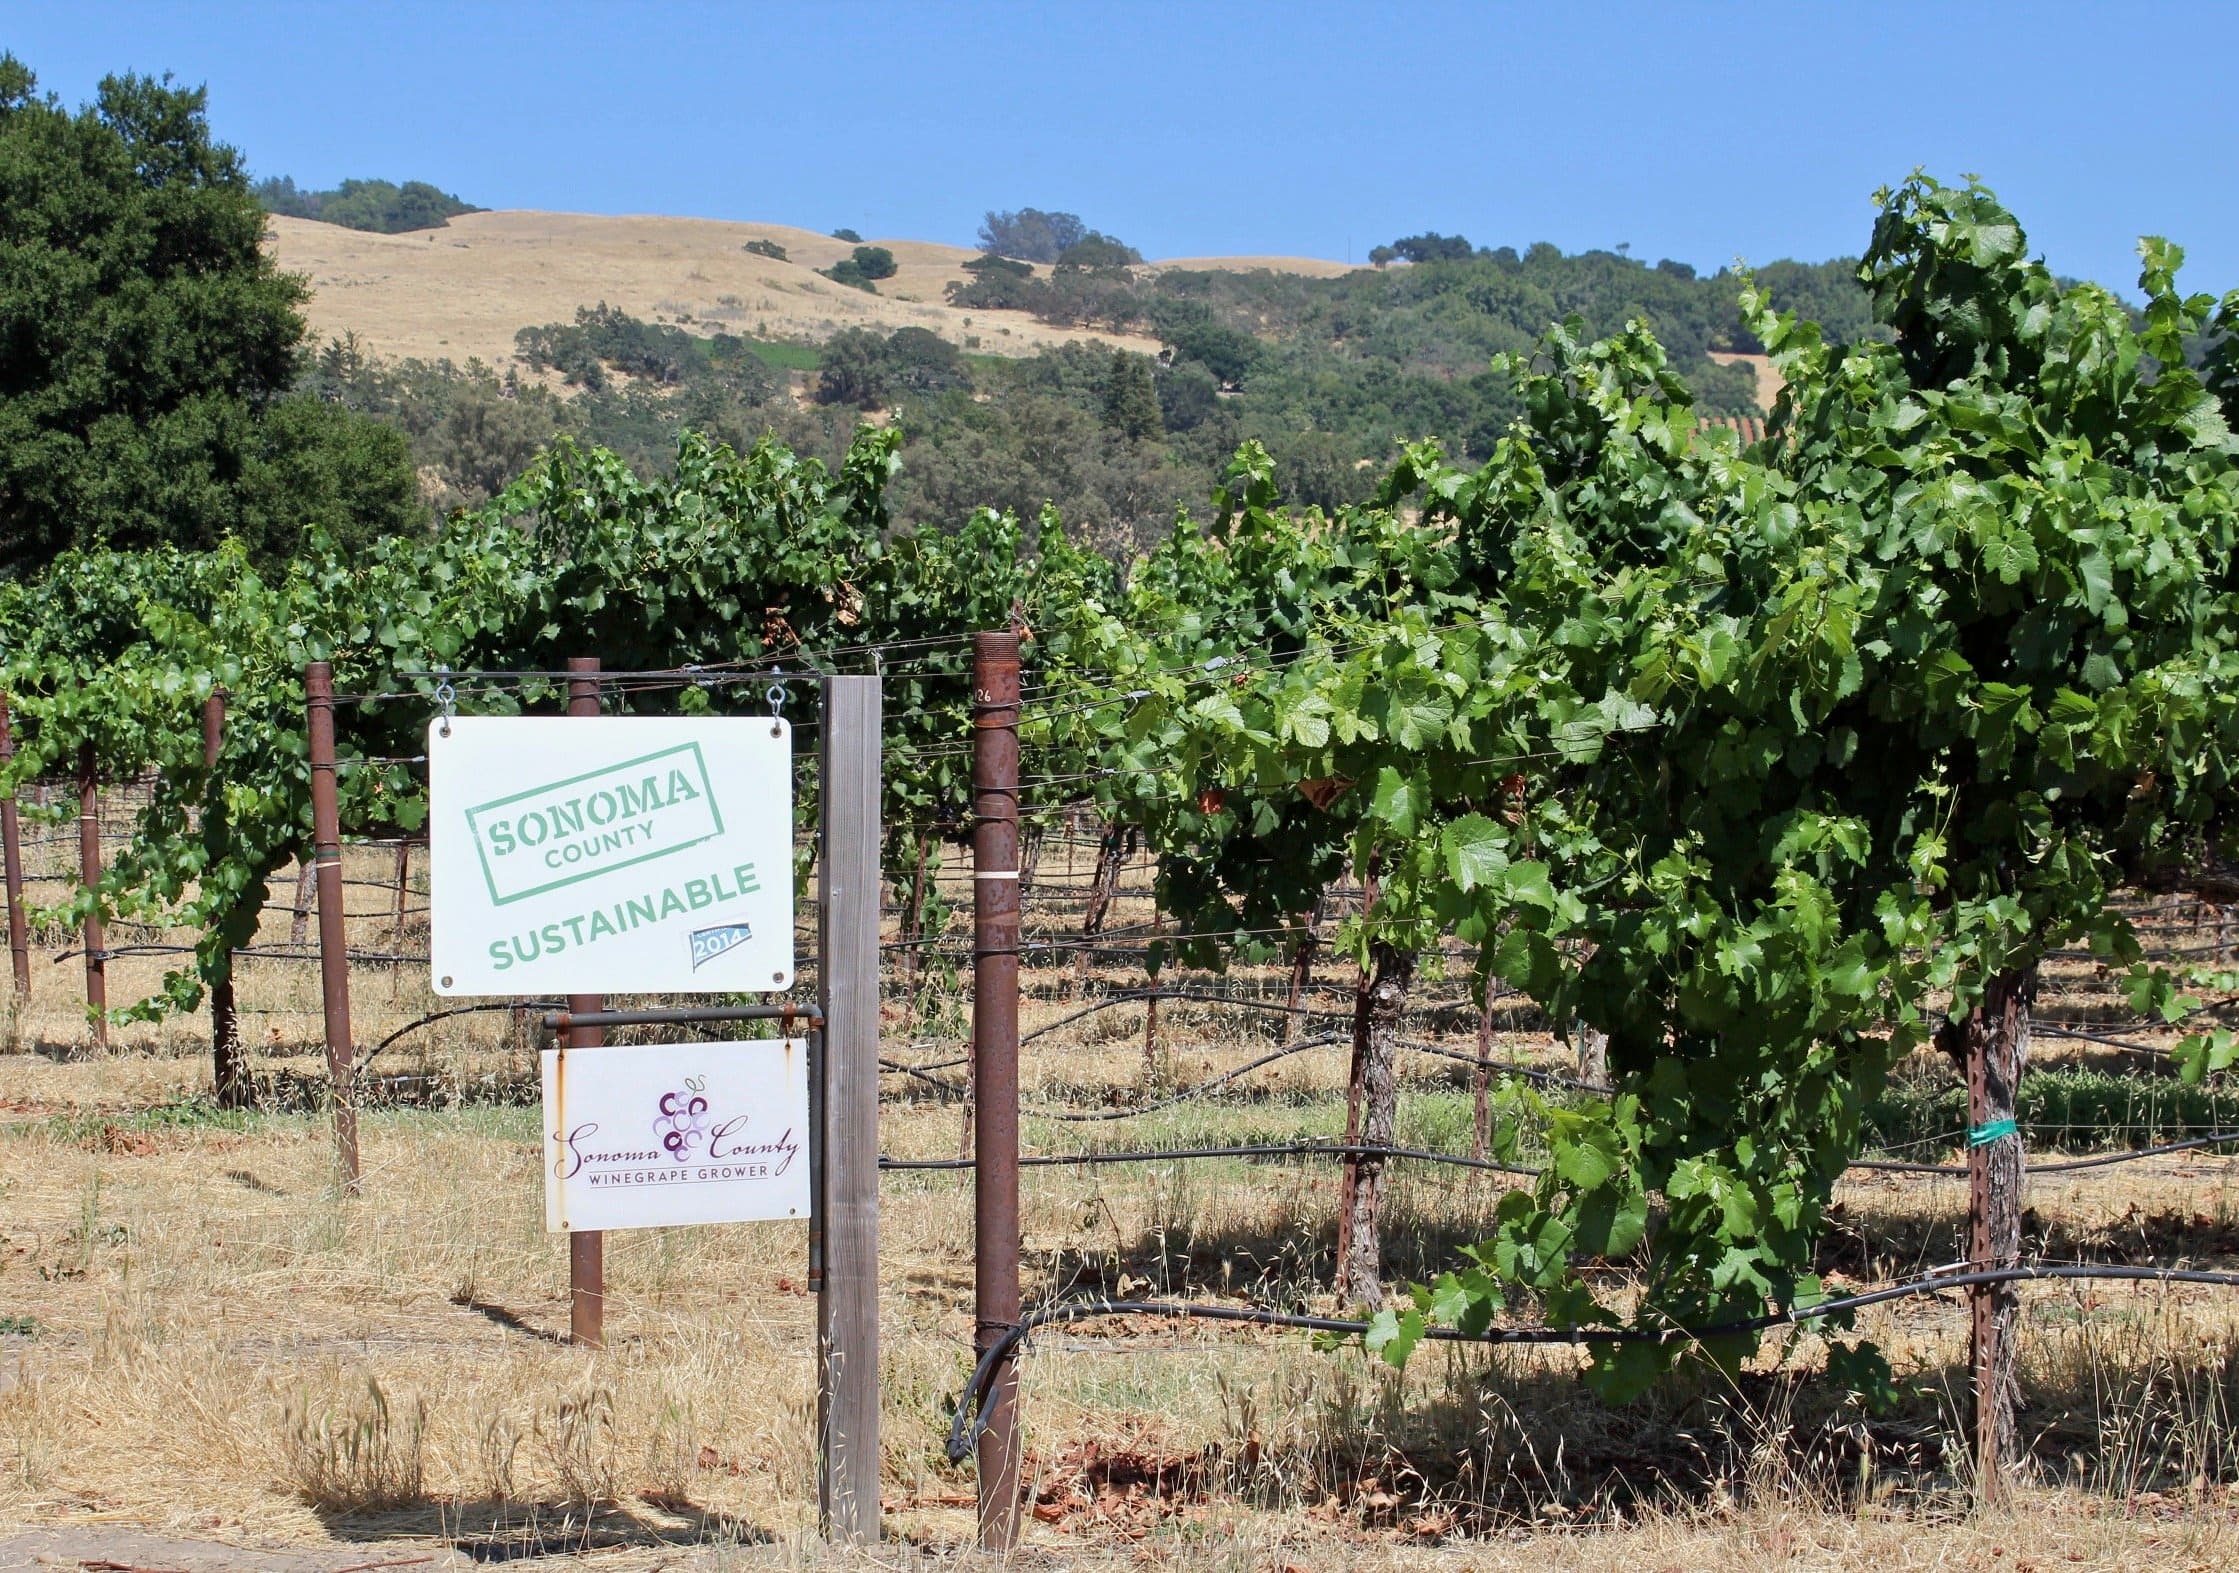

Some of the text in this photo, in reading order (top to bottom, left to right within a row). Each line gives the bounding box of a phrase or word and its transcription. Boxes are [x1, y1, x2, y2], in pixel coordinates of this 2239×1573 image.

[488, 769, 700, 856] SONOMA
[544, 820, 654, 868] COUNTY
[488, 862, 760, 970] SUSTAINABLE
[553, 1115, 800, 1180] Sonoma County
[589, 1165, 768, 1185] WINEGRAPE GROWER
